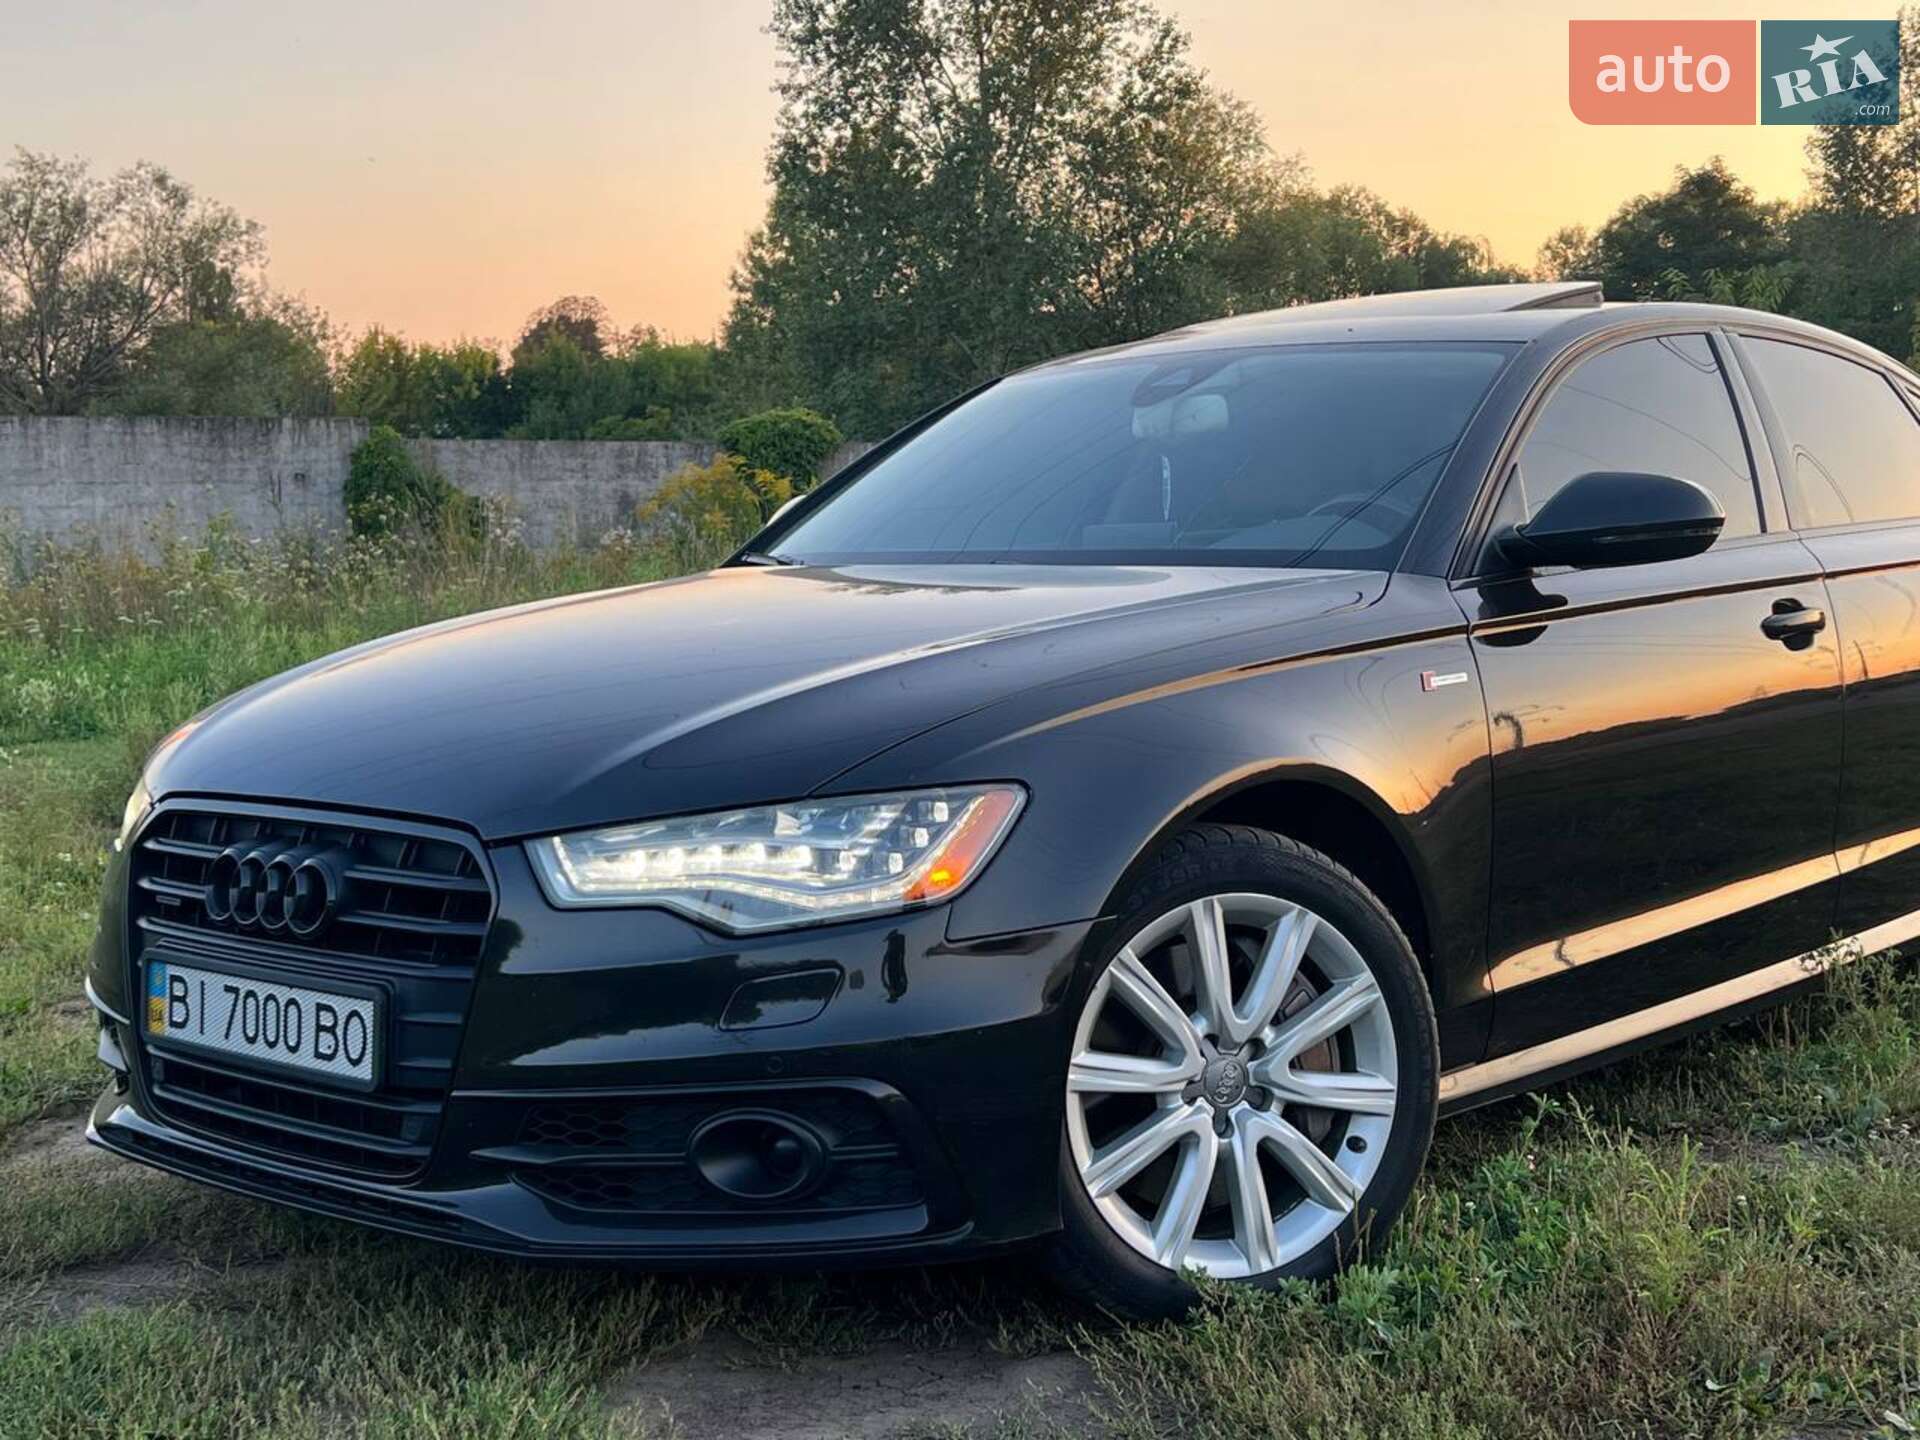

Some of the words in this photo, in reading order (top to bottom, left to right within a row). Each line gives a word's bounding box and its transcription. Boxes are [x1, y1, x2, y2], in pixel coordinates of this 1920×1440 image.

[169, 974, 205, 1035] BI
[223, 984, 302, 1054] 7000
[314, 1002, 367, 1067] BO
